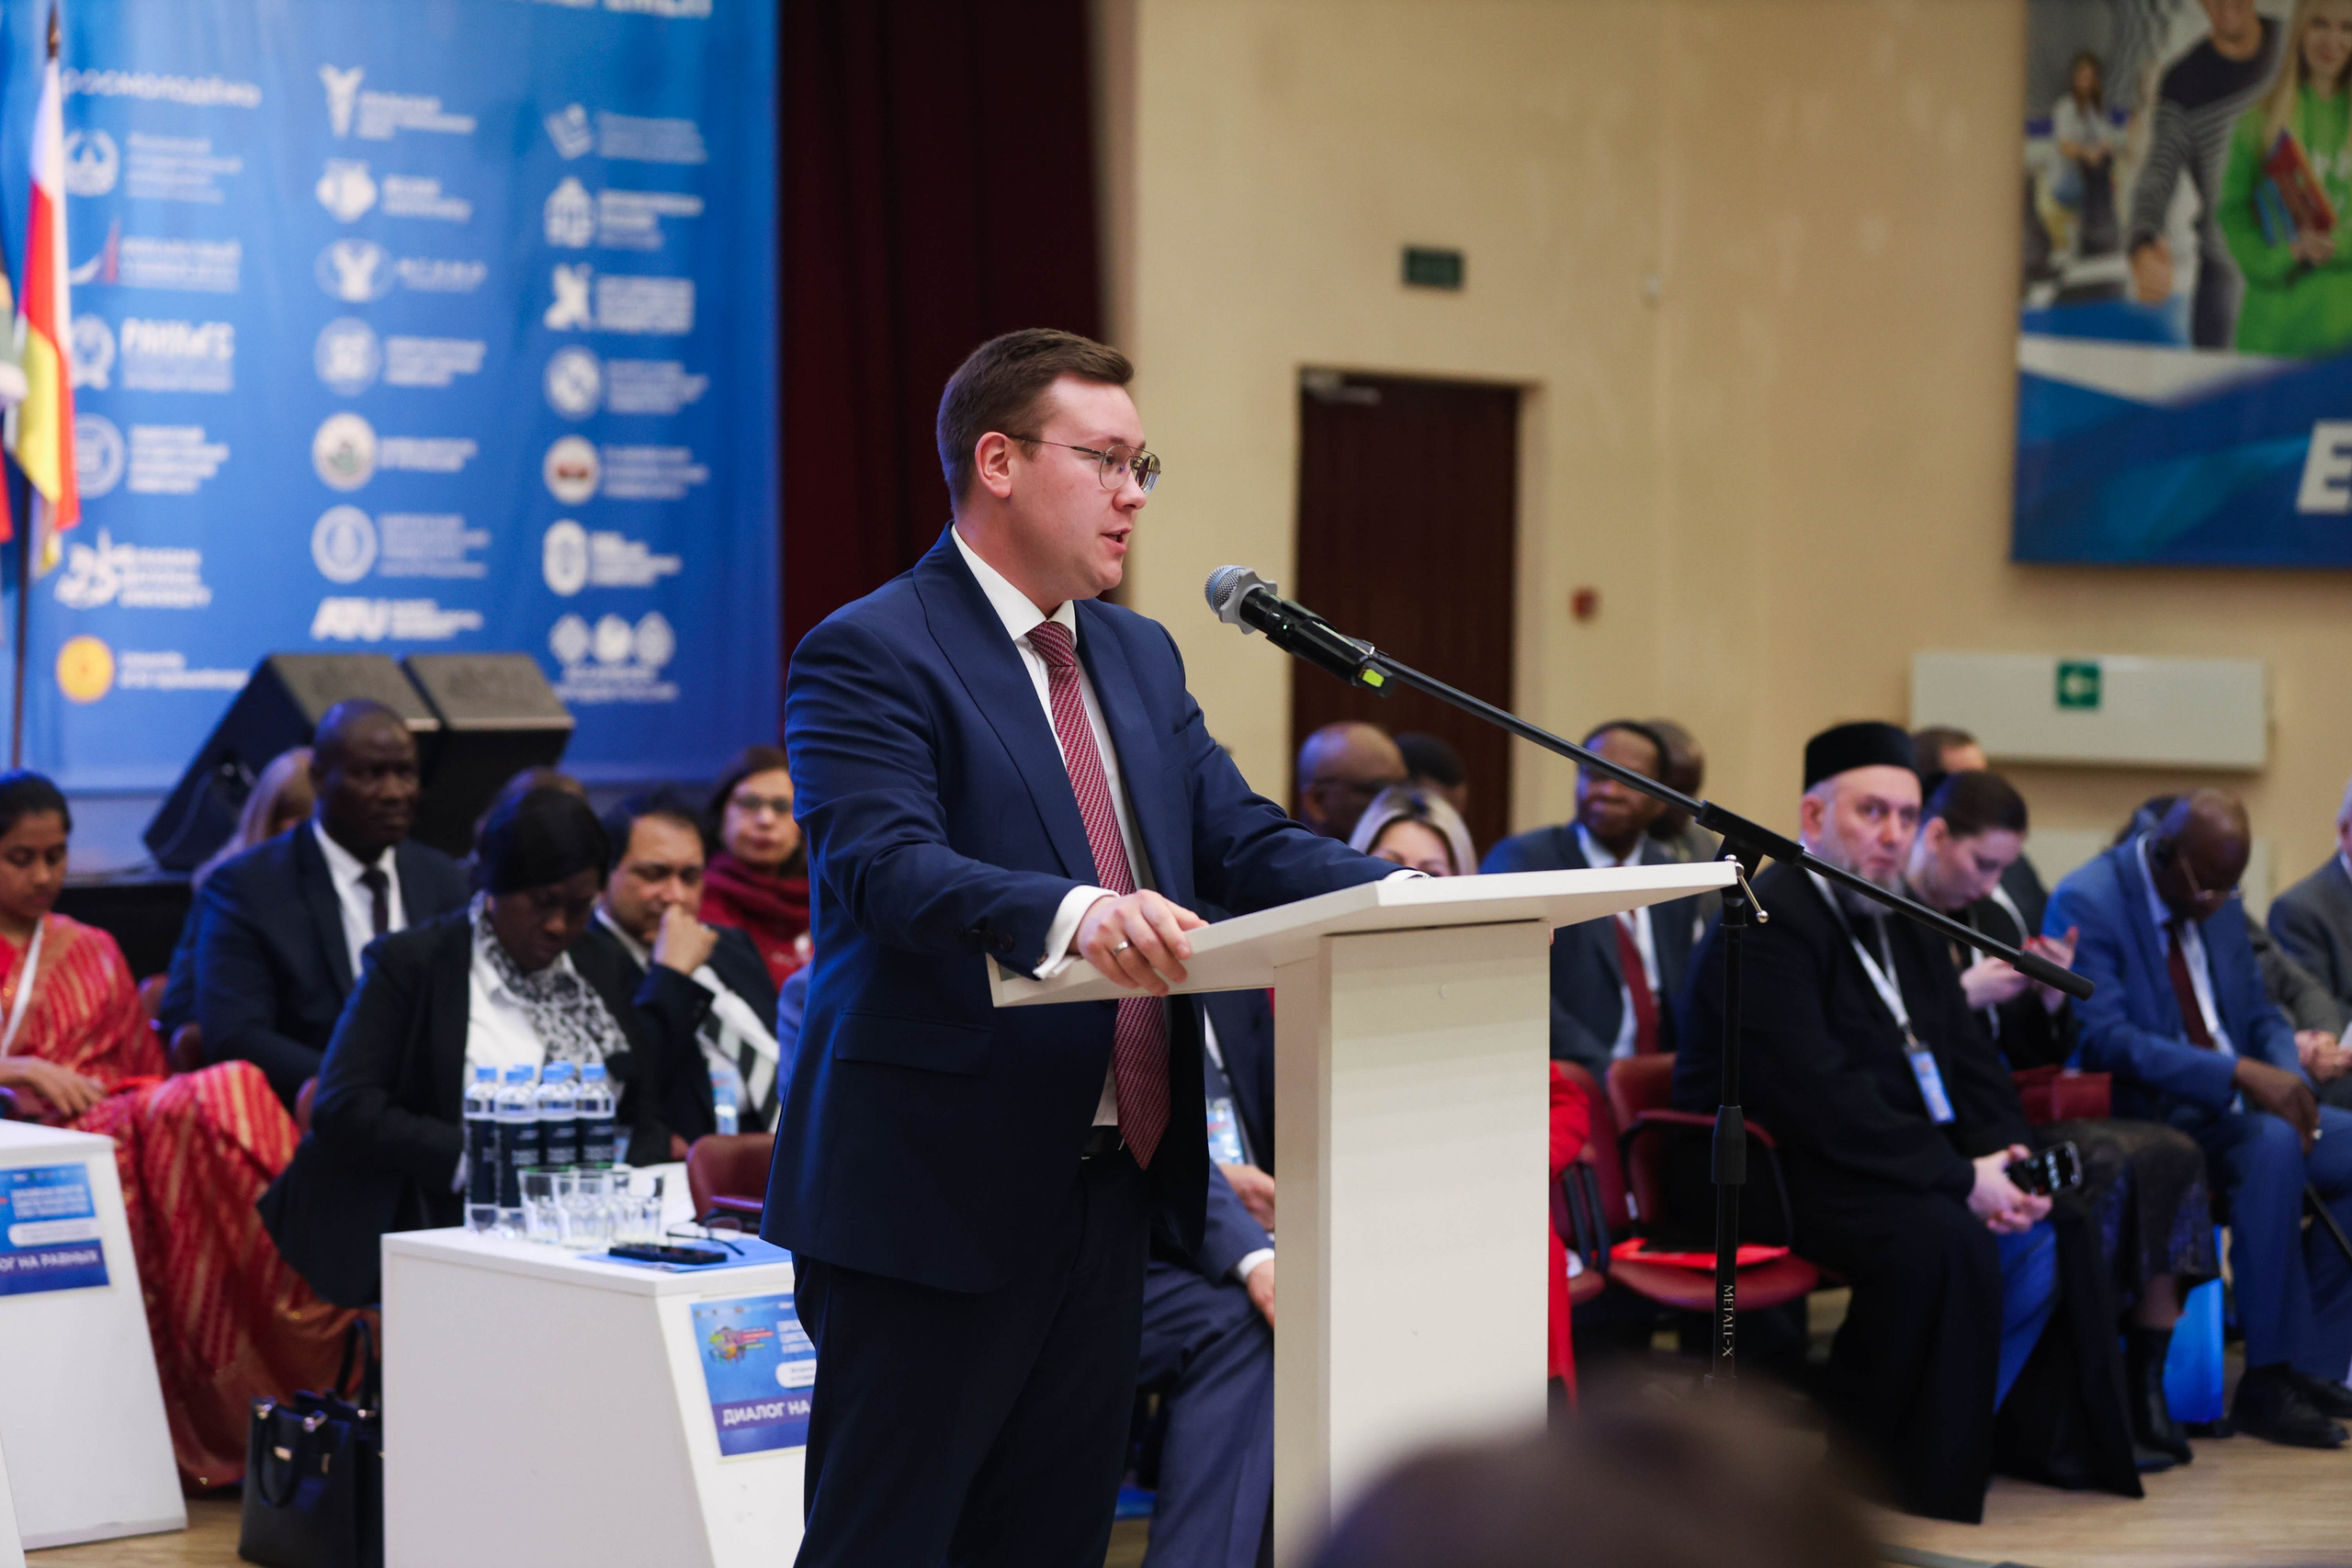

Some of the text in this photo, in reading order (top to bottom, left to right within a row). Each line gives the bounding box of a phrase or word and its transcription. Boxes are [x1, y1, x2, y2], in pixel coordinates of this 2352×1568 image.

[18, 1255, 40, 1269] НА
[1723, 1284, 1734, 1357] METALL-X
[723, 1399, 810, 1426] ДИАЛОГ НА
